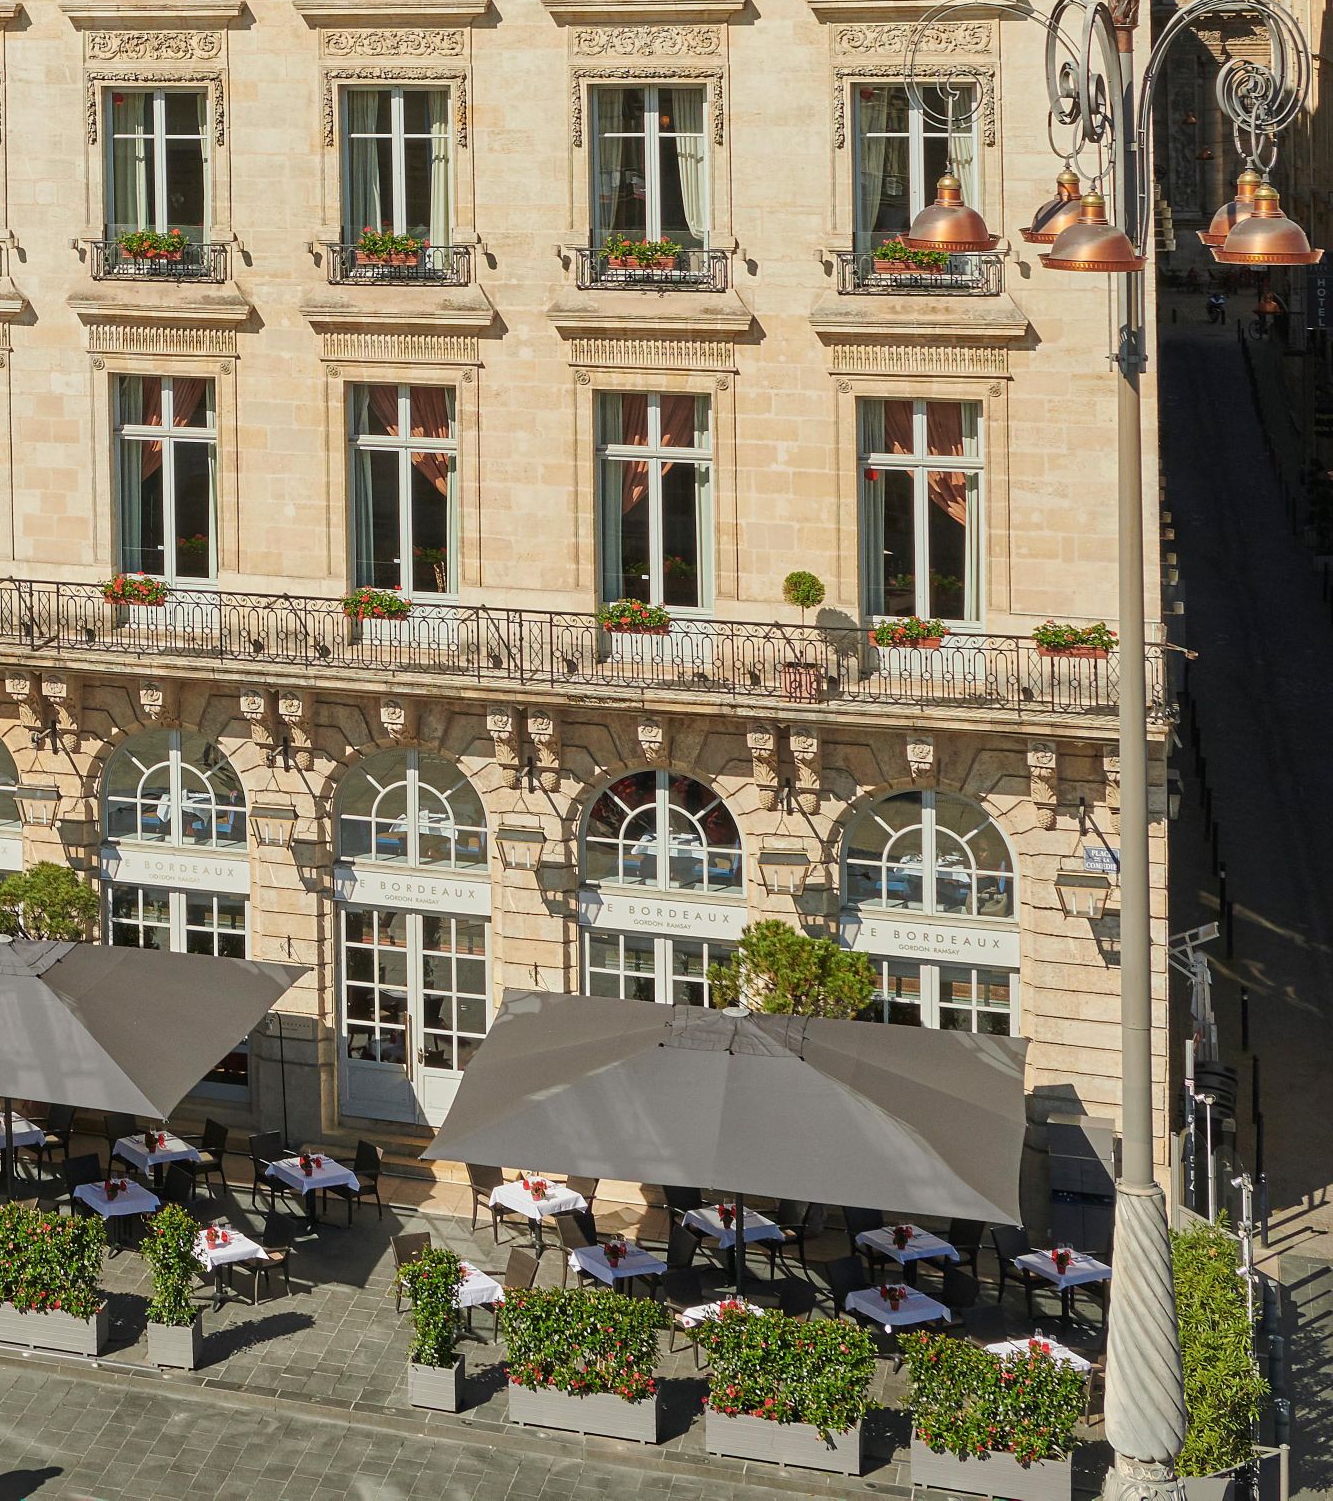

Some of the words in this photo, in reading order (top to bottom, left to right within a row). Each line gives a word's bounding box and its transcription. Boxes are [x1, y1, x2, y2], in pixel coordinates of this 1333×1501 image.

[1317, 278, 1326, 327] HOTEL
[1091, 849, 1112, 858] PLAC
[144, 860, 234, 877] BORDEAUX
[380, 881, 476, 899] BORDEAUX
[384, 894, 413, 902] GORDON
[415, 897, 440, 906] RAMSAY
[629, 905, 730, 924] BORDEAUX
[633, 918, 664, 927] GORDON
[666, 922, 693, 930] RAMSAY
[893, 929, 1000, 949] BORDEAUX
[898, 944, 930, 952] GORDON
[933, 947, 960, 956] RAMSAY
